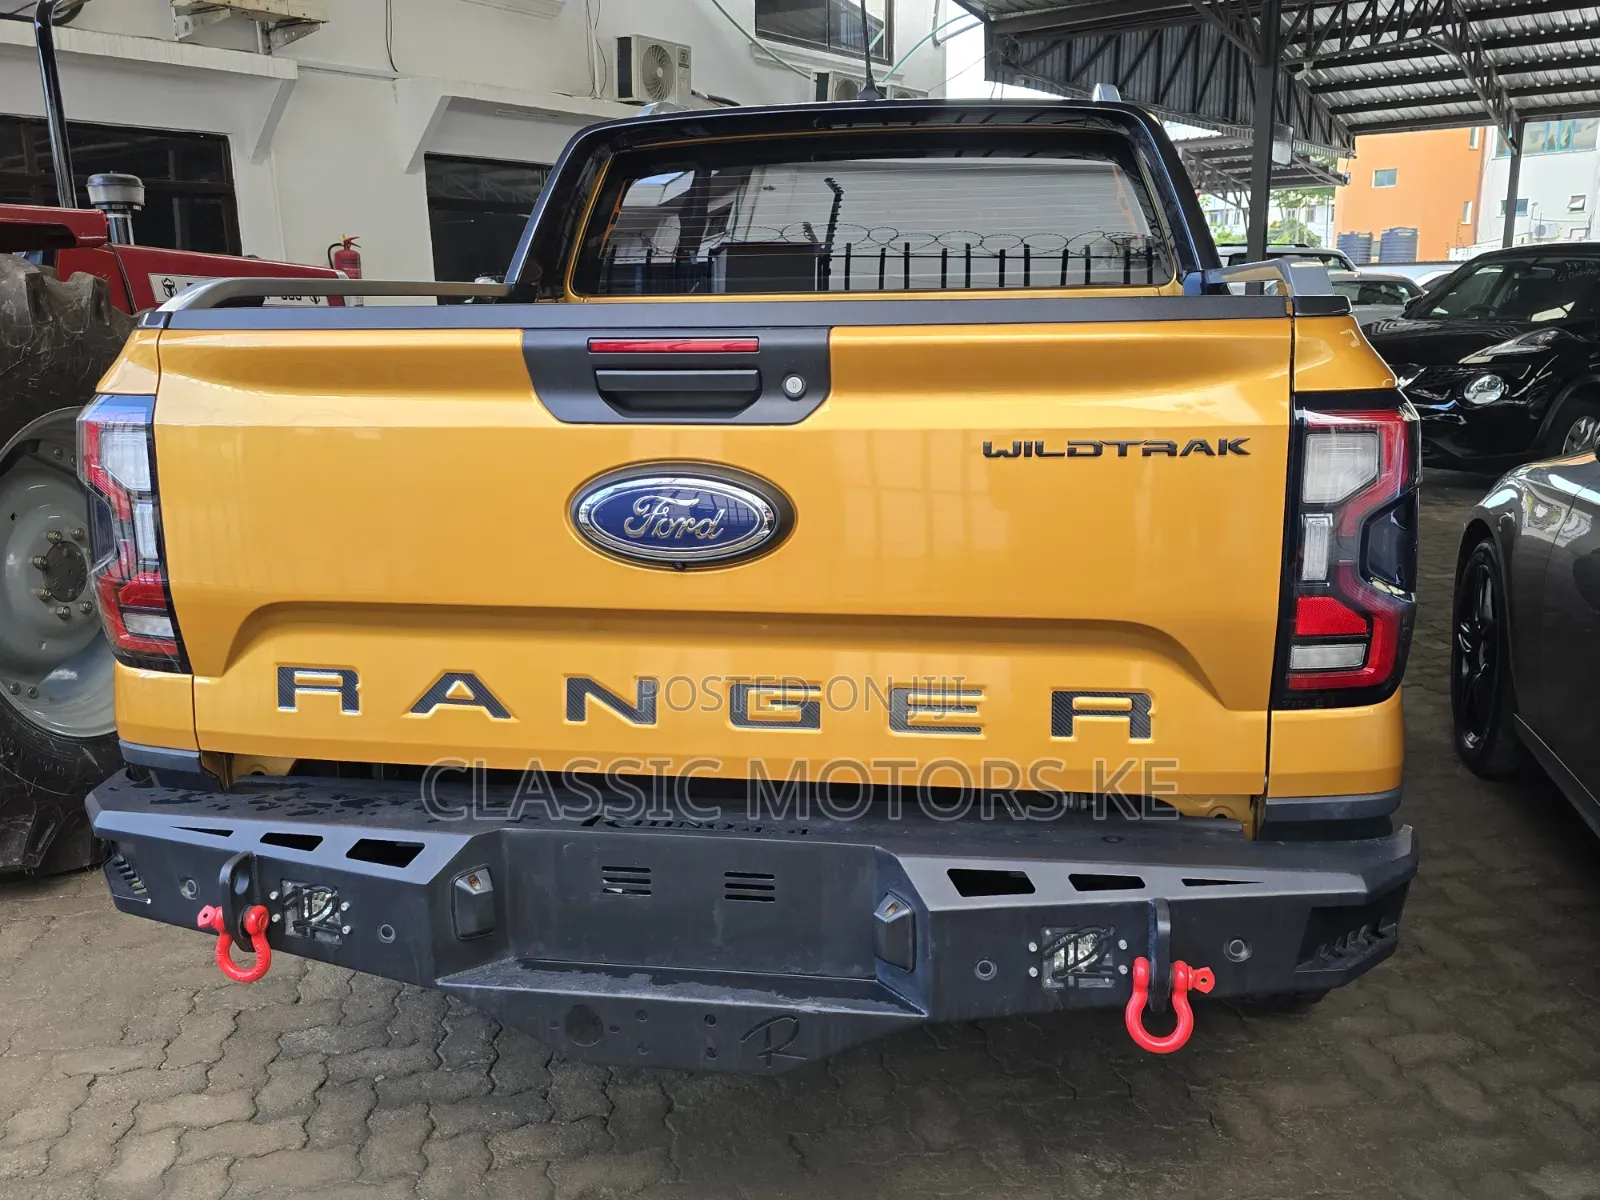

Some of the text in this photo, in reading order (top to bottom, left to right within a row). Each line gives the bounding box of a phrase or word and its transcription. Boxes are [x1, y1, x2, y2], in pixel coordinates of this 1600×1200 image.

[982, 437, 1251, 458] WILDTRAK
[623, 495, 726, 540] Ford
[276, 665, 1153, 739] RANGER
